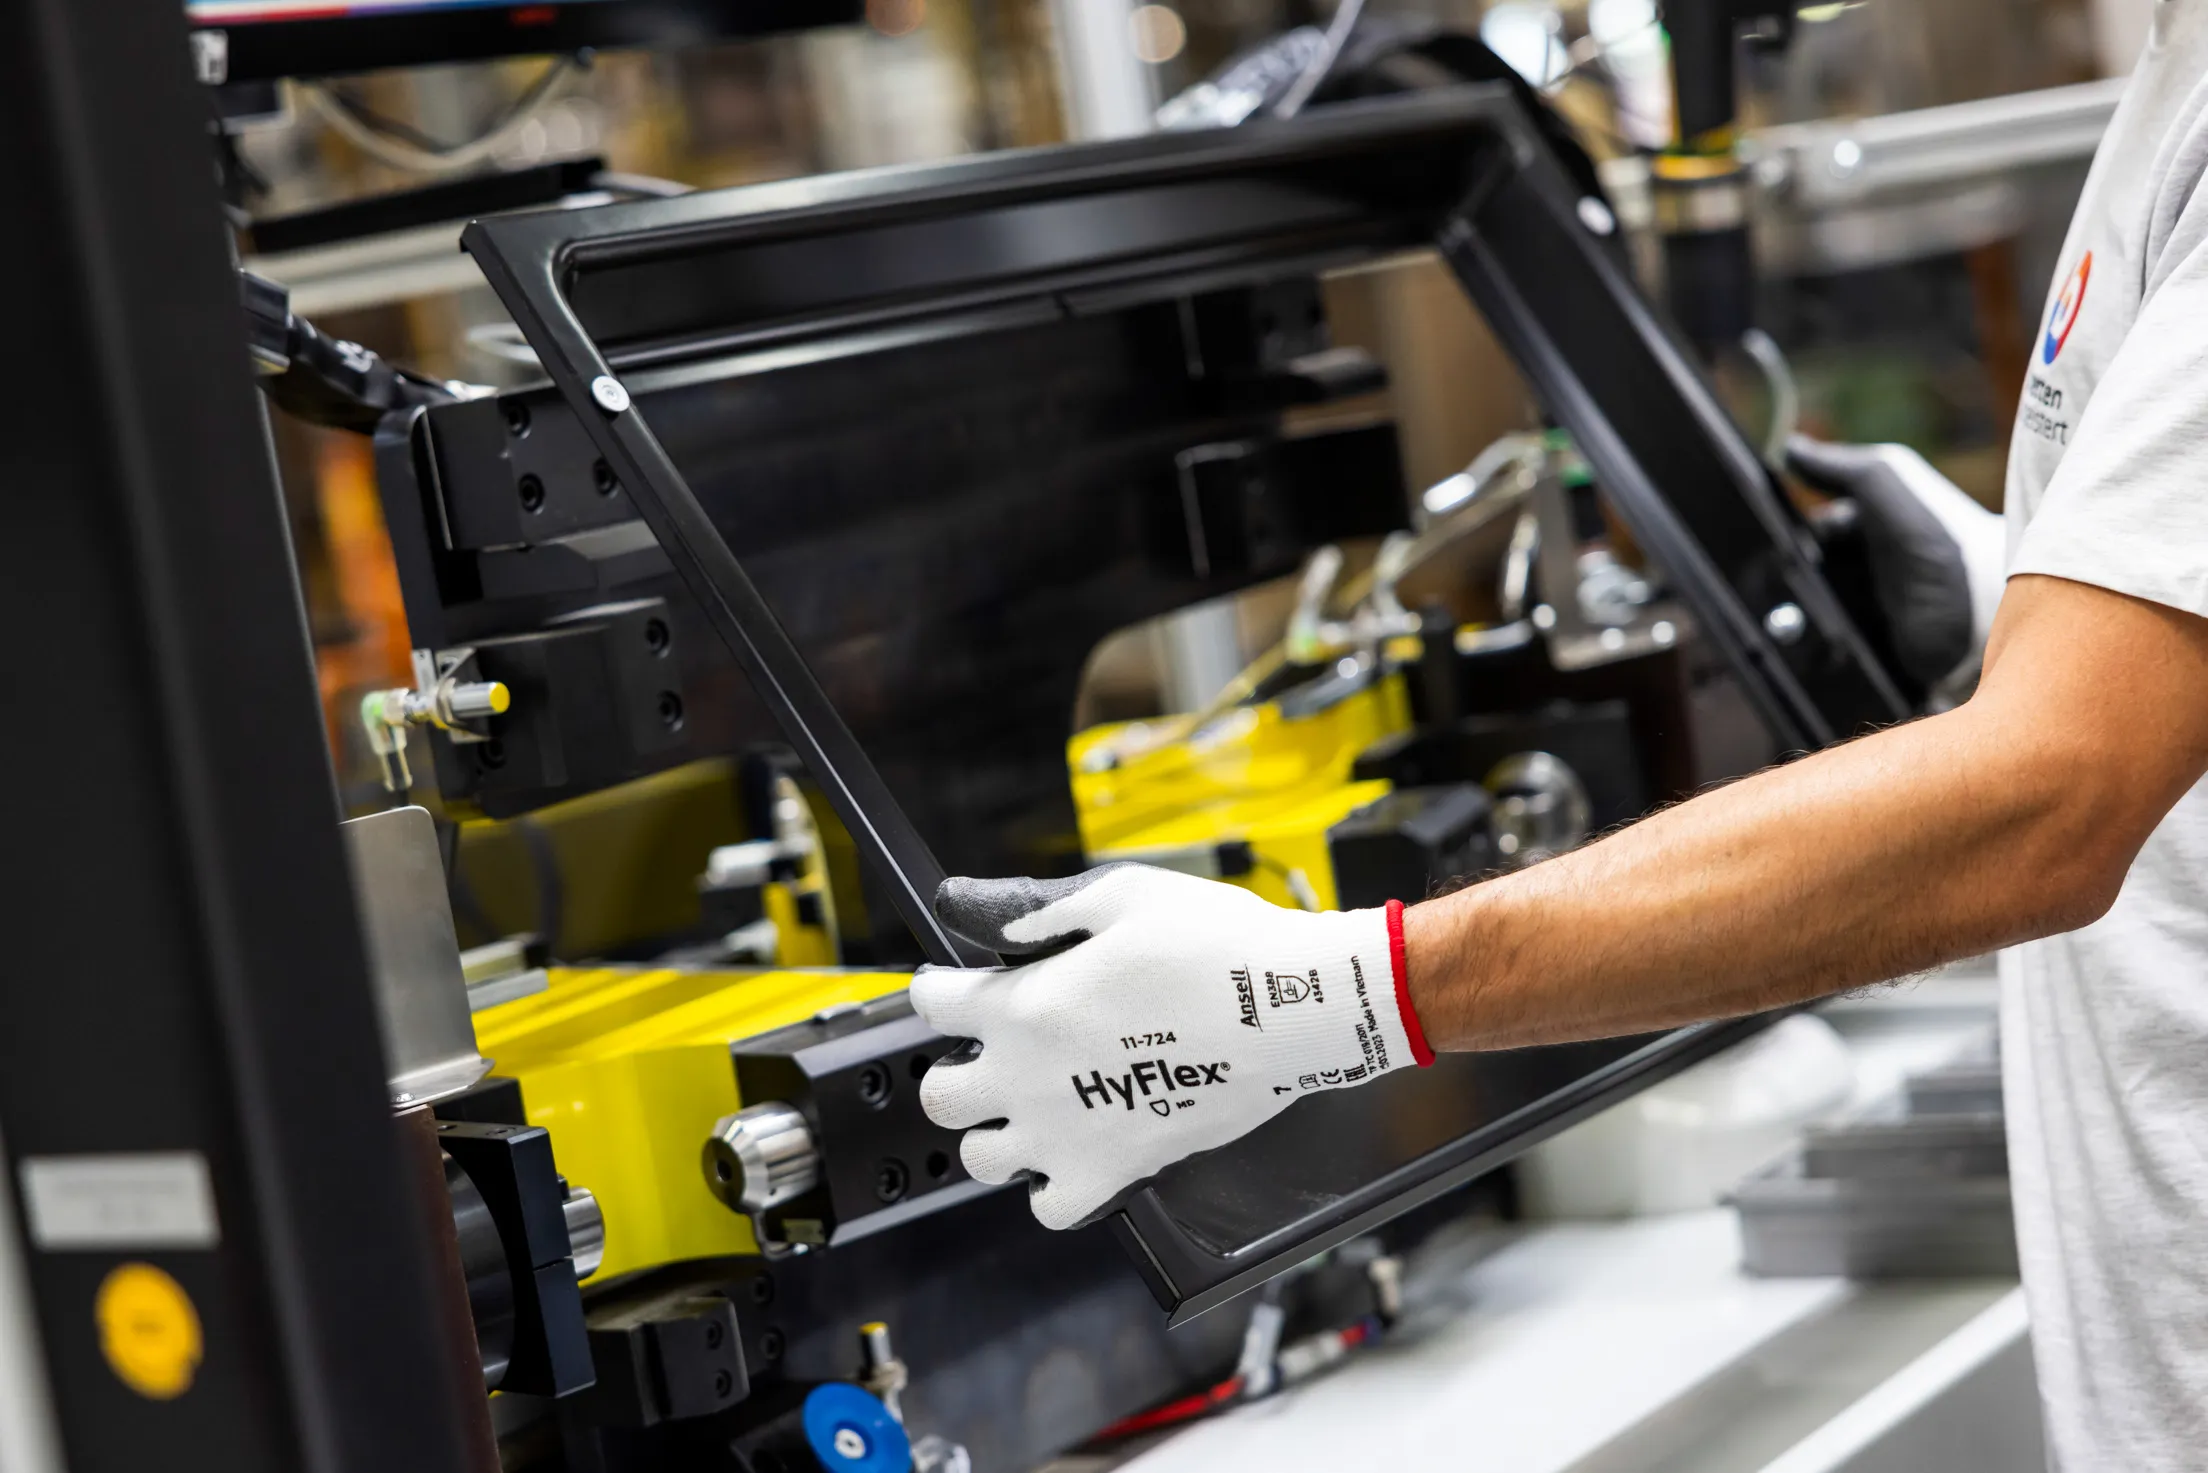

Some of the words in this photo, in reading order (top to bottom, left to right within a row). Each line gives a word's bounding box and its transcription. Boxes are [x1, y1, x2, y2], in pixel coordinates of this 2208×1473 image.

[1265, 971, 1281, 1008] EN388
[1309, 969, 1324, 1004] 4342B
[1351, 955, 1367, 998] Vietnam
[1230, 969, 1257, 1028] Ansell
[1360, 998, 1370, 1009] in
[1364, 1009, 1379, 1032] Made
[1120, 1031, 1177, 1050] 11-724
[1176, 1099, 1196, 1110] MD
